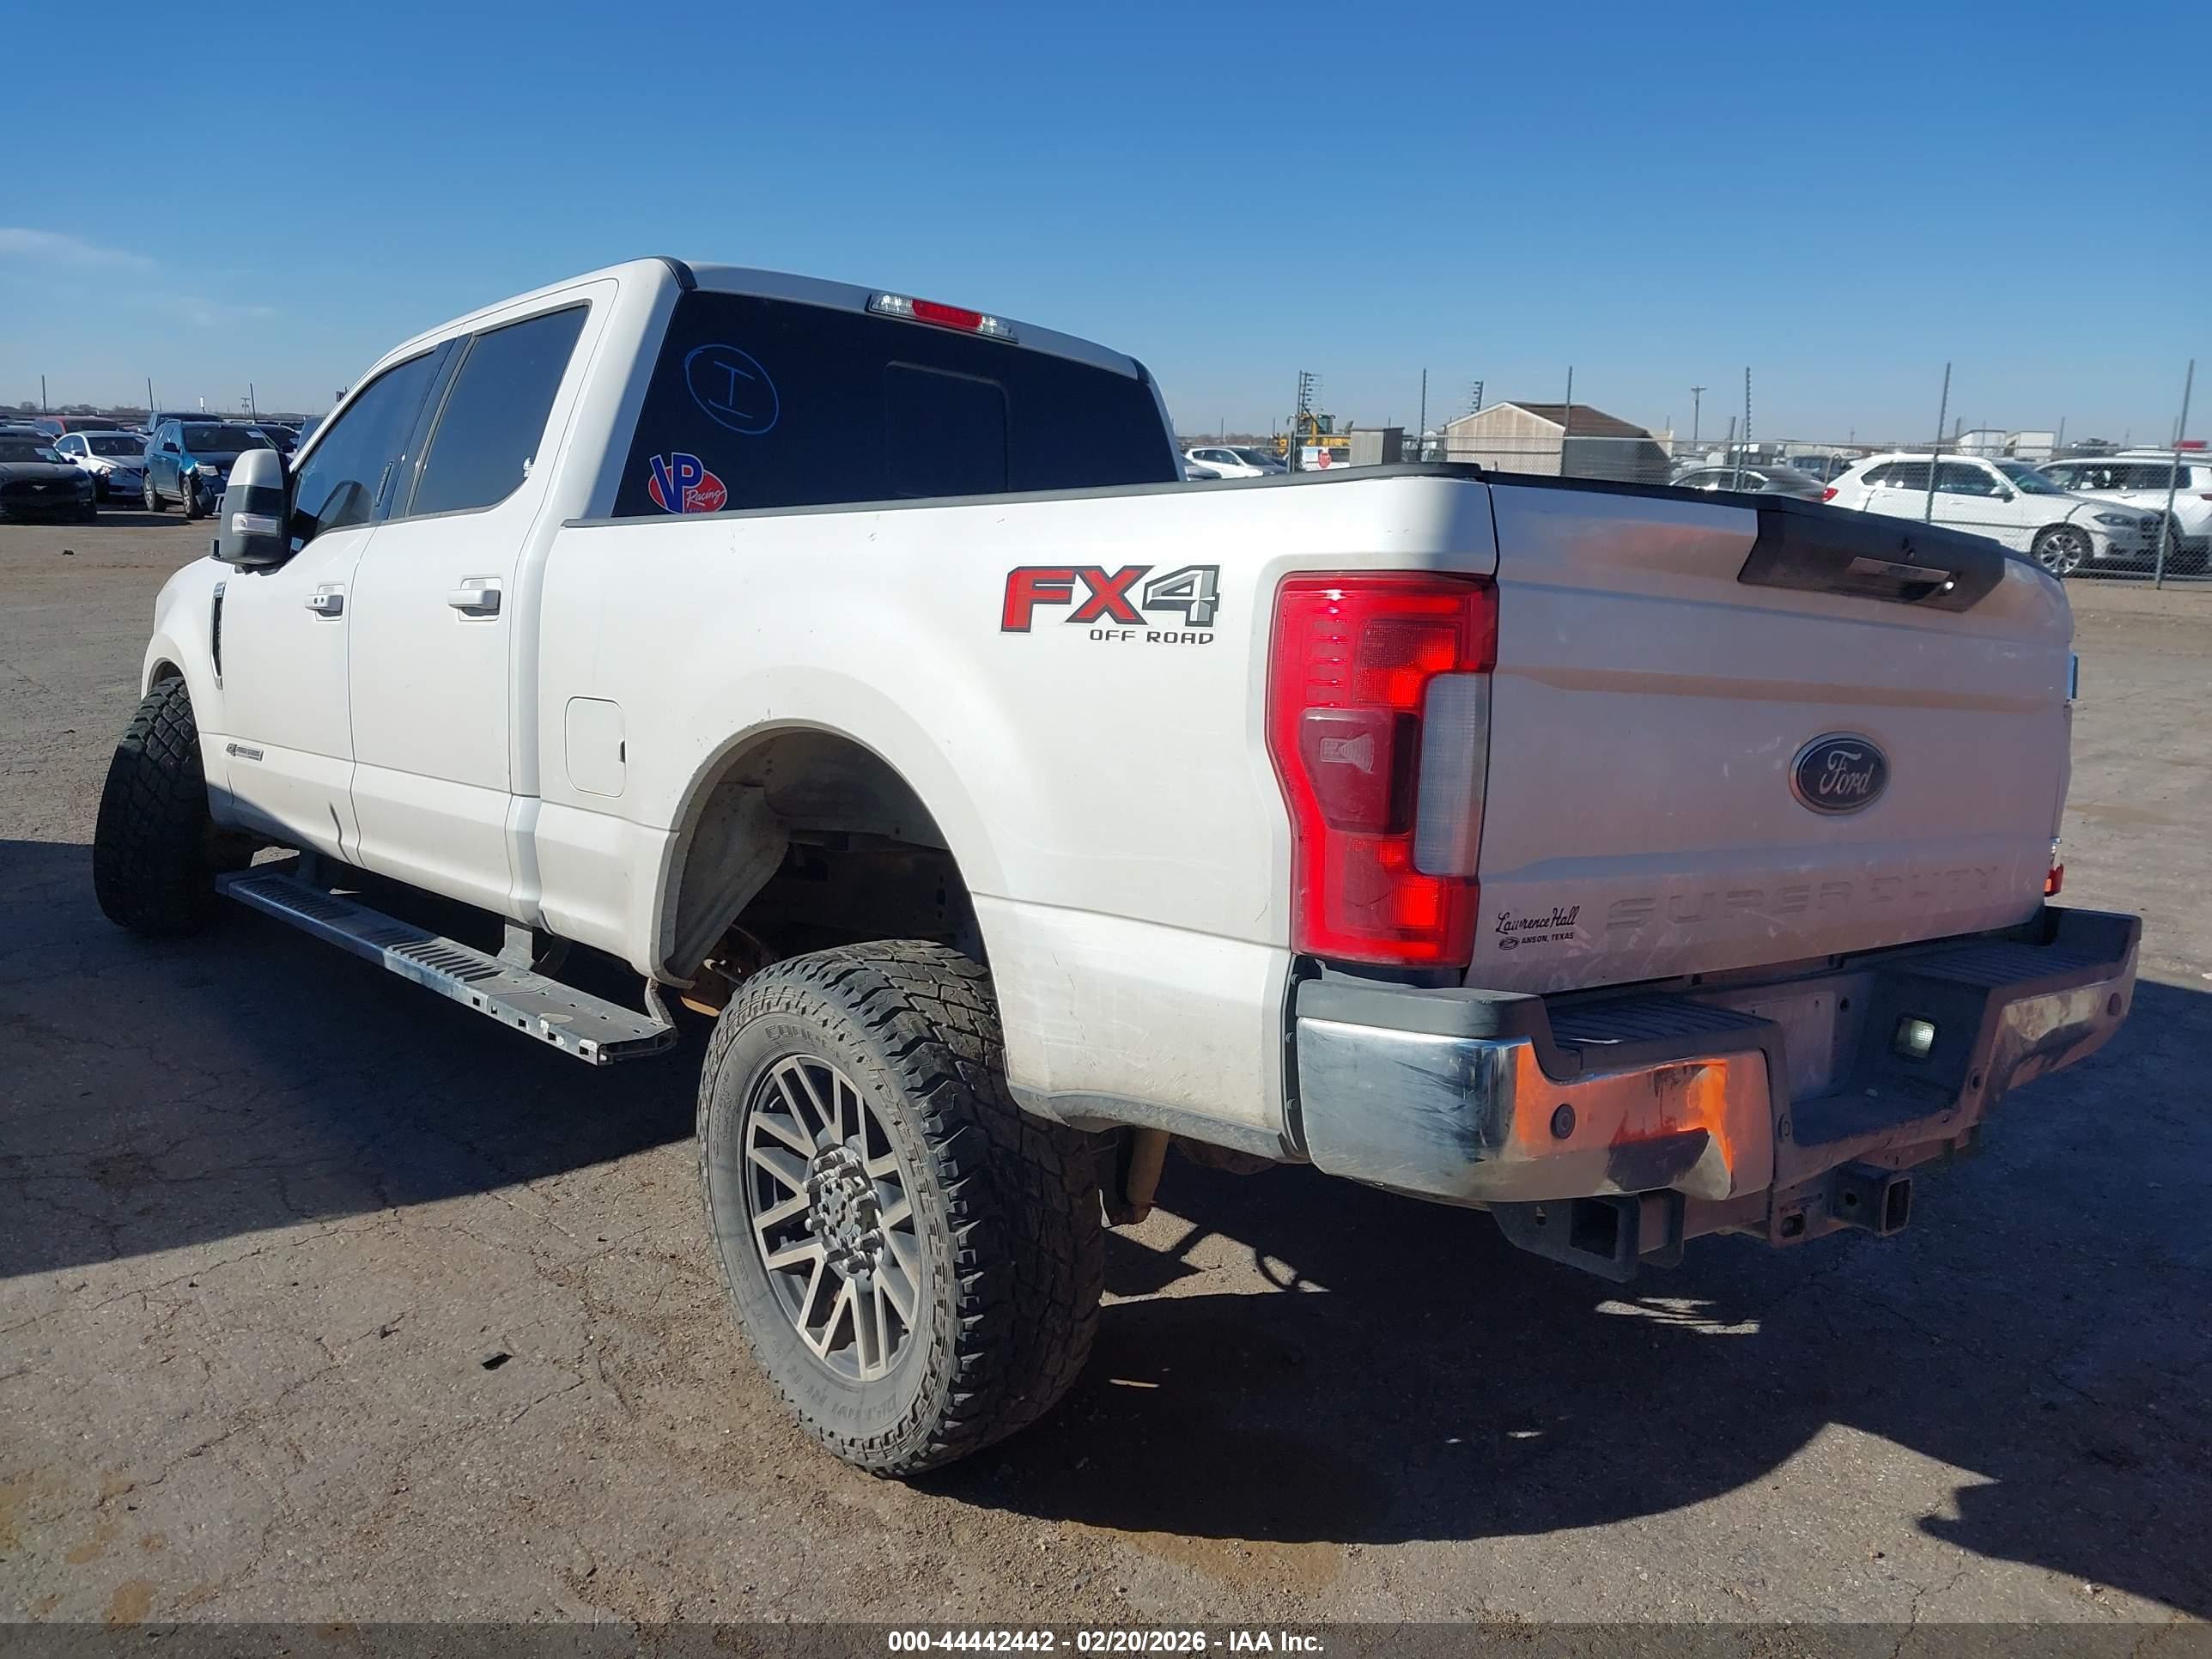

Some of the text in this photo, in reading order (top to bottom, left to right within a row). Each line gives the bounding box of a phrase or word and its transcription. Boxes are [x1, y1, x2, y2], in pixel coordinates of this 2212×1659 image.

[649, 452, 704, 515] VP
[686, 487, 726, 508] Racing
[1000, 564, 1221, 633] FX4
[1089, 629, 1214, 645] OFF ROAD
[1819, 750, 1875, 795] Ford
[1495, 906, 1580, 935] Lawrence Hall
[1522, 934, 1549, 944] ANSON,
[1552, 933, 1574, 942] TEXAS
